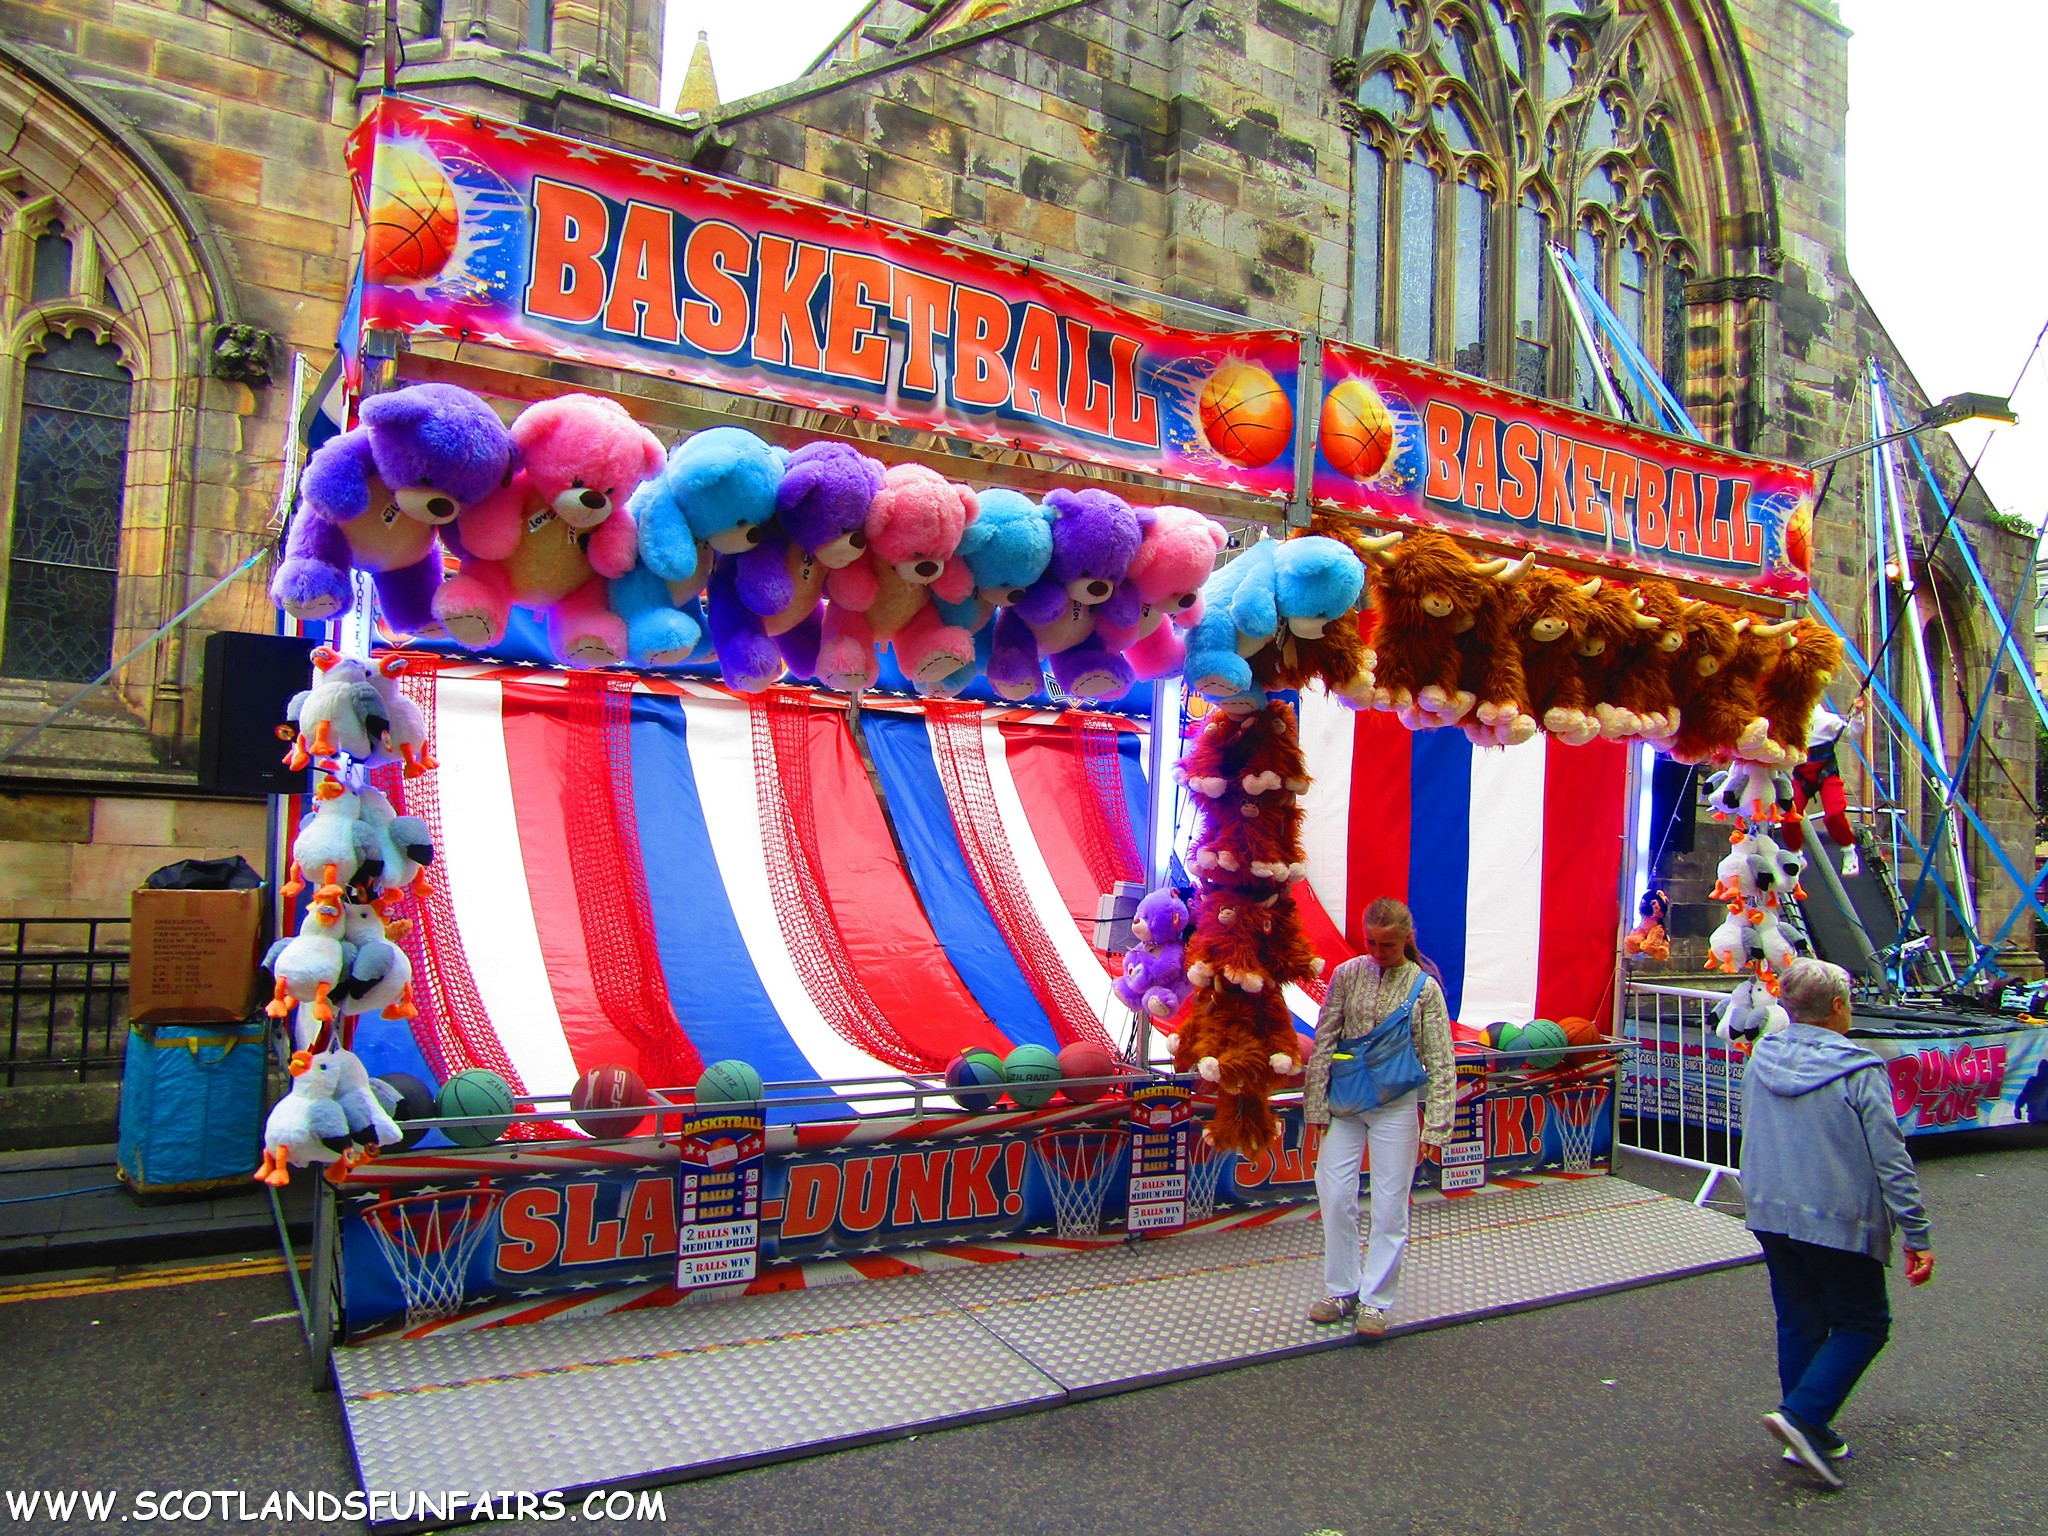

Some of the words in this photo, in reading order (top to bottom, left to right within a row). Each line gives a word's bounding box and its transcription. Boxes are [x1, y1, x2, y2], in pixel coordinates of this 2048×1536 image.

[525, 176, 1159, 448] BASKETBALL
[1424, 400, 1763, 566] BASKETBALL
[1010, 1073, 1050, 1082] ZILAND
[1887, 1042, 2008, 1119] BUNGEE
[1133, 1085, 1190, 1101] BASKETBALL
[1915, 1086, 1982, 1129] ZONE
[684, 1115, 764, 1137] BASKETBALL
[1450, 1146, 1469, 1155] BALLS
[1469, 1144, 1481, 1152] WIN
[1466, 1153, 1483, 1161] PRIZE
[700, 1171, 735, 1187] BALLS
[1450, 1170, 1469, 1178] BALLS
[1469, 1168, 1481, 1176] WIN
[1134, 1180, 1140, 1191] 2
[1142, 1180, 1165, 1189] BALLS
[1166, 1179, 1181, 1188] WIN
[700, 1188, 734, 1203] BALLS
[1131, 1190, 1160, 1200] MEDIUM
[1162, 1188, 1184, 1198] PRIZE
[498, 1141, 1027, 1274] SLA-DUNK!
[699, 1205, 733, 1219] BALLS
[1132, 1207, 1140, 1218] 3
[1141, 1207, 1164, 1217] BALLS
[1165, 1206, 1180, 1214] WIN
[1137, 1217, 1152, 1227] ANY
[1153, 1216, 1176, 1225] PRIZE
[686, 1228, 696, 1241] 2
[697, 1227, 730, 1240] BALLS
[732, 1224, 753, 1236] WIN
[681, 1240, 724, 1254] MEDIUM
[725, 1236, 756, 1250] PRIZE
[685, 1261, 693, 1274] 3
[696, 1259, 729, 1272] BALLS
[730, 1256, 751, 1268] WIN
[690, 1273, 712, 1285] ANY
[714, 1269, 745, 1281] PRIZE
